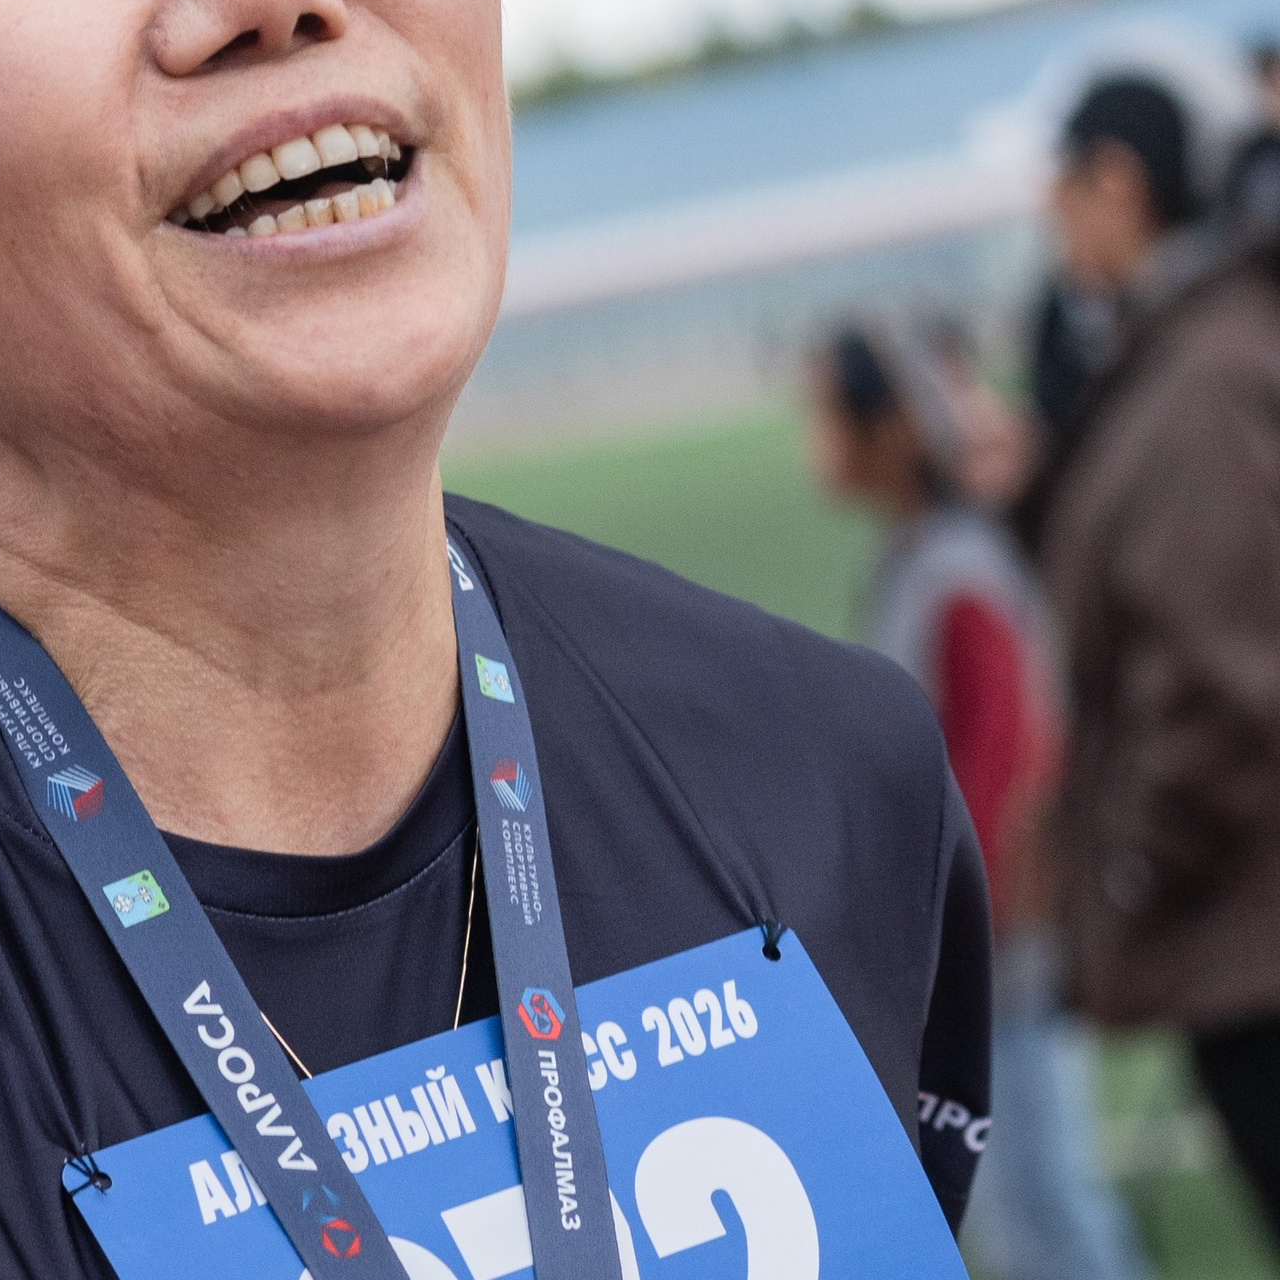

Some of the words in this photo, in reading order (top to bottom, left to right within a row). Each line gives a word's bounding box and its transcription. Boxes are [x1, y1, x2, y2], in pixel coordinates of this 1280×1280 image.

[14, 677, 70, 755] КОМПЛЕКС
[502, 819, 518, 905] КОМПЛЕКС
[513, 821, 534, 925] СПОРТИВНЫЙ
[524, 823, 541, 922] КУЛЬТУРНО-
[183, 979, 318, 1171] АЛРОСА
[189, 1065, 477, 1226] АЛЗНЫЙ
[476, 1022, 637, 1123] КСС
[642, 980, 759, 1067] 2026
[538, 1050, 581, 1230] ПРОФАЛМАЗ
